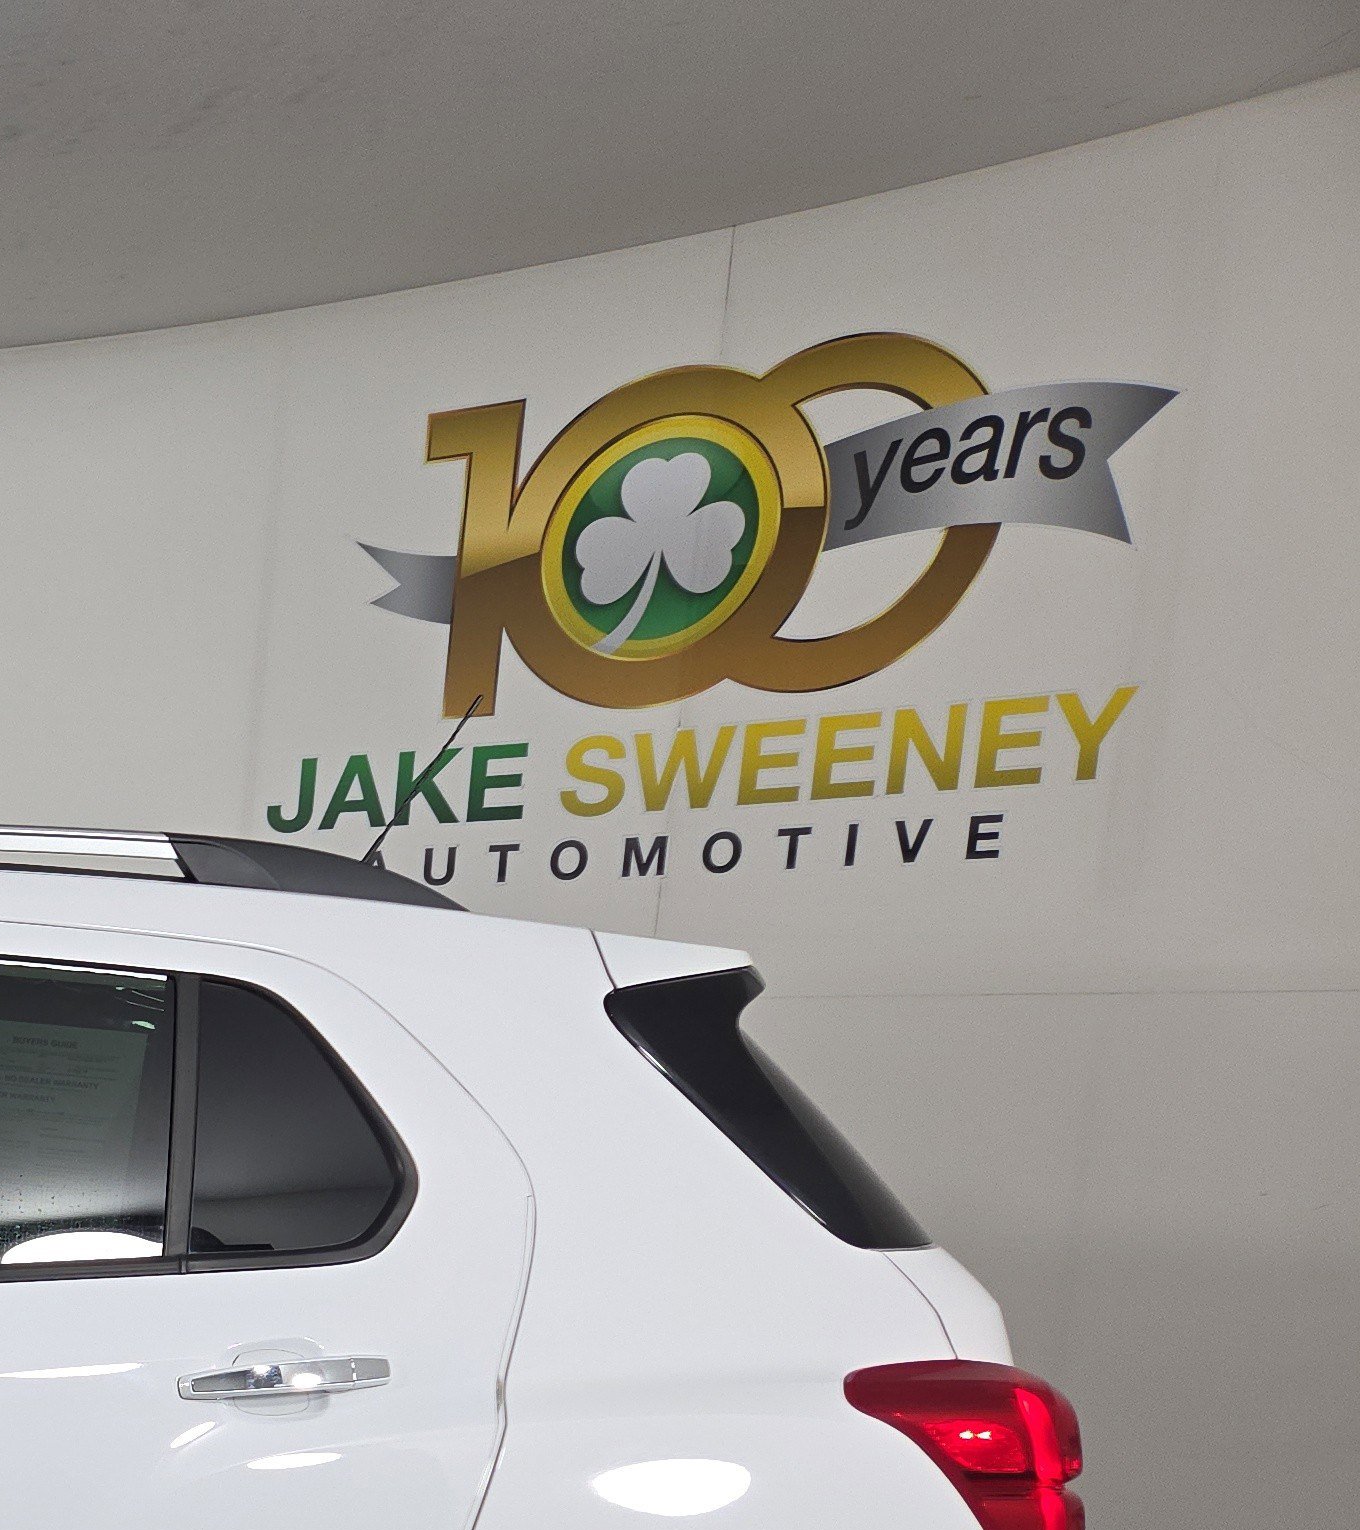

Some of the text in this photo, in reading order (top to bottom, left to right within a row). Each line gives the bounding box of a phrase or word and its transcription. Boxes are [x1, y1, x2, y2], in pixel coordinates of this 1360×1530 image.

[843, 404, 1094, 530] years
[266, 684, 1139, 835] JAKE SWEENEY
